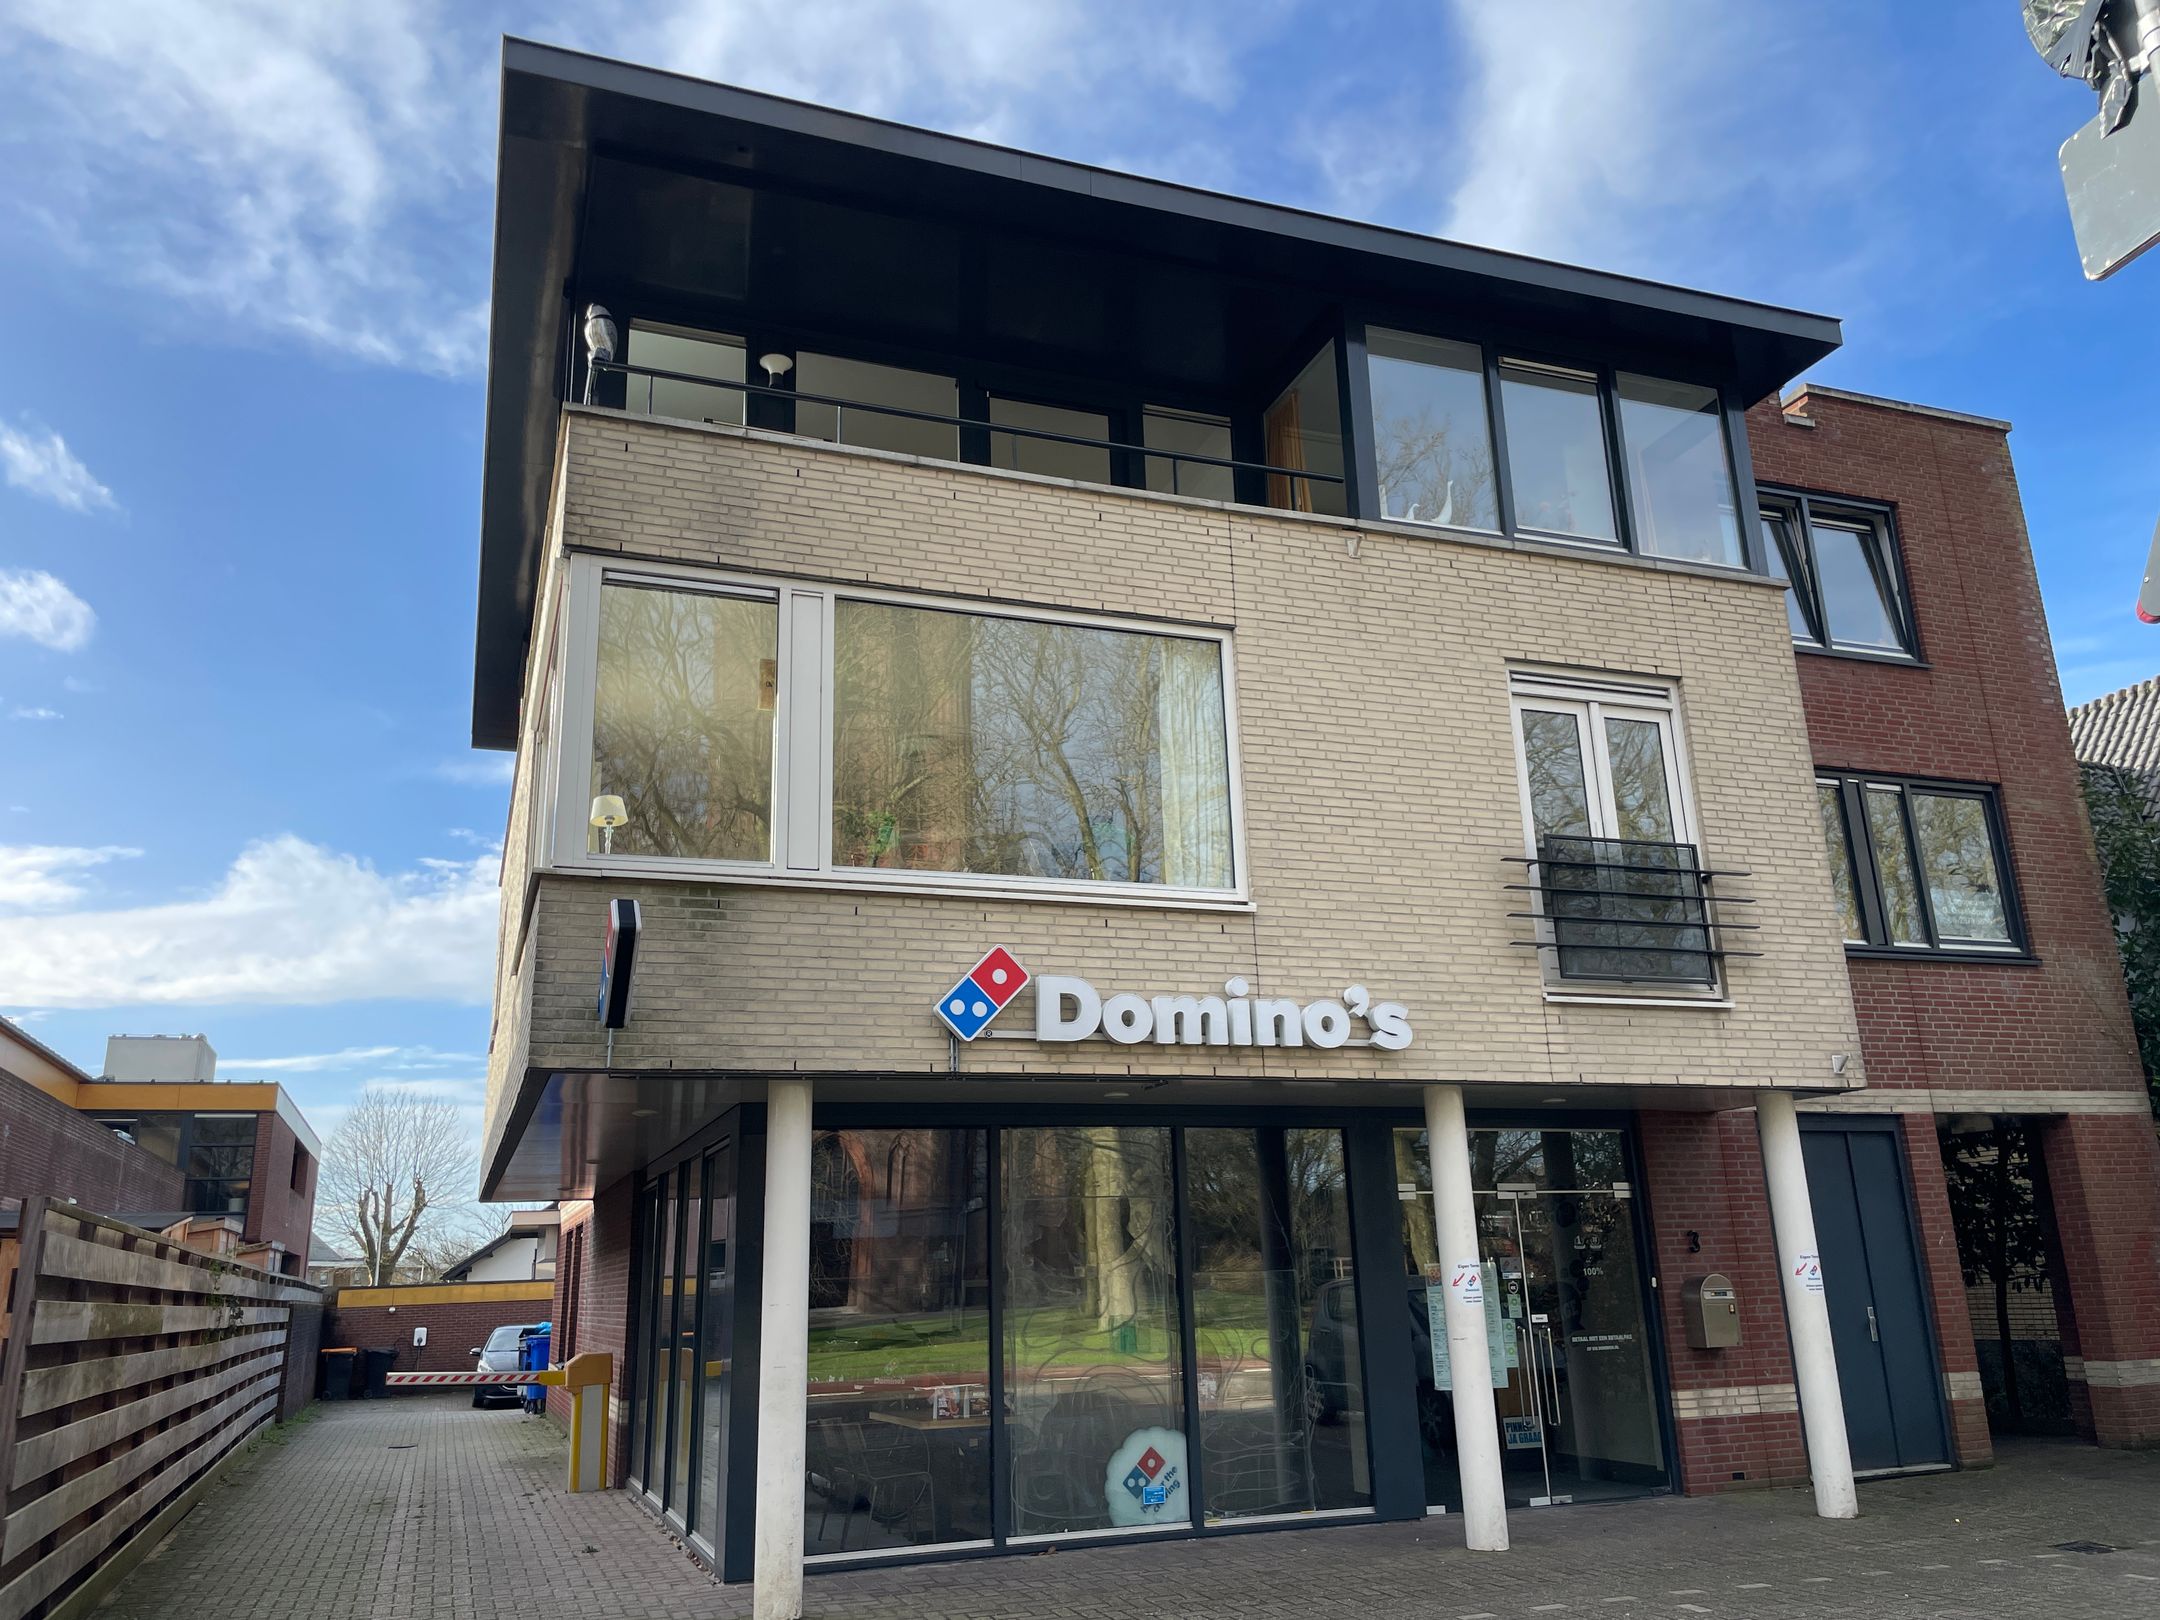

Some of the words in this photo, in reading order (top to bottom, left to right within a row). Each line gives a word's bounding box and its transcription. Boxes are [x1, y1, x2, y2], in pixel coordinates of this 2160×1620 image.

[1034, 974, 1414, 1052] Domino's
[1686, 1230, 1701, 1253] 3
[1583, 1267, 1605, 1276] 100%
[1508, 1433, 1518, 1444] JA
[1164, 1466, 1177, 1482] the
